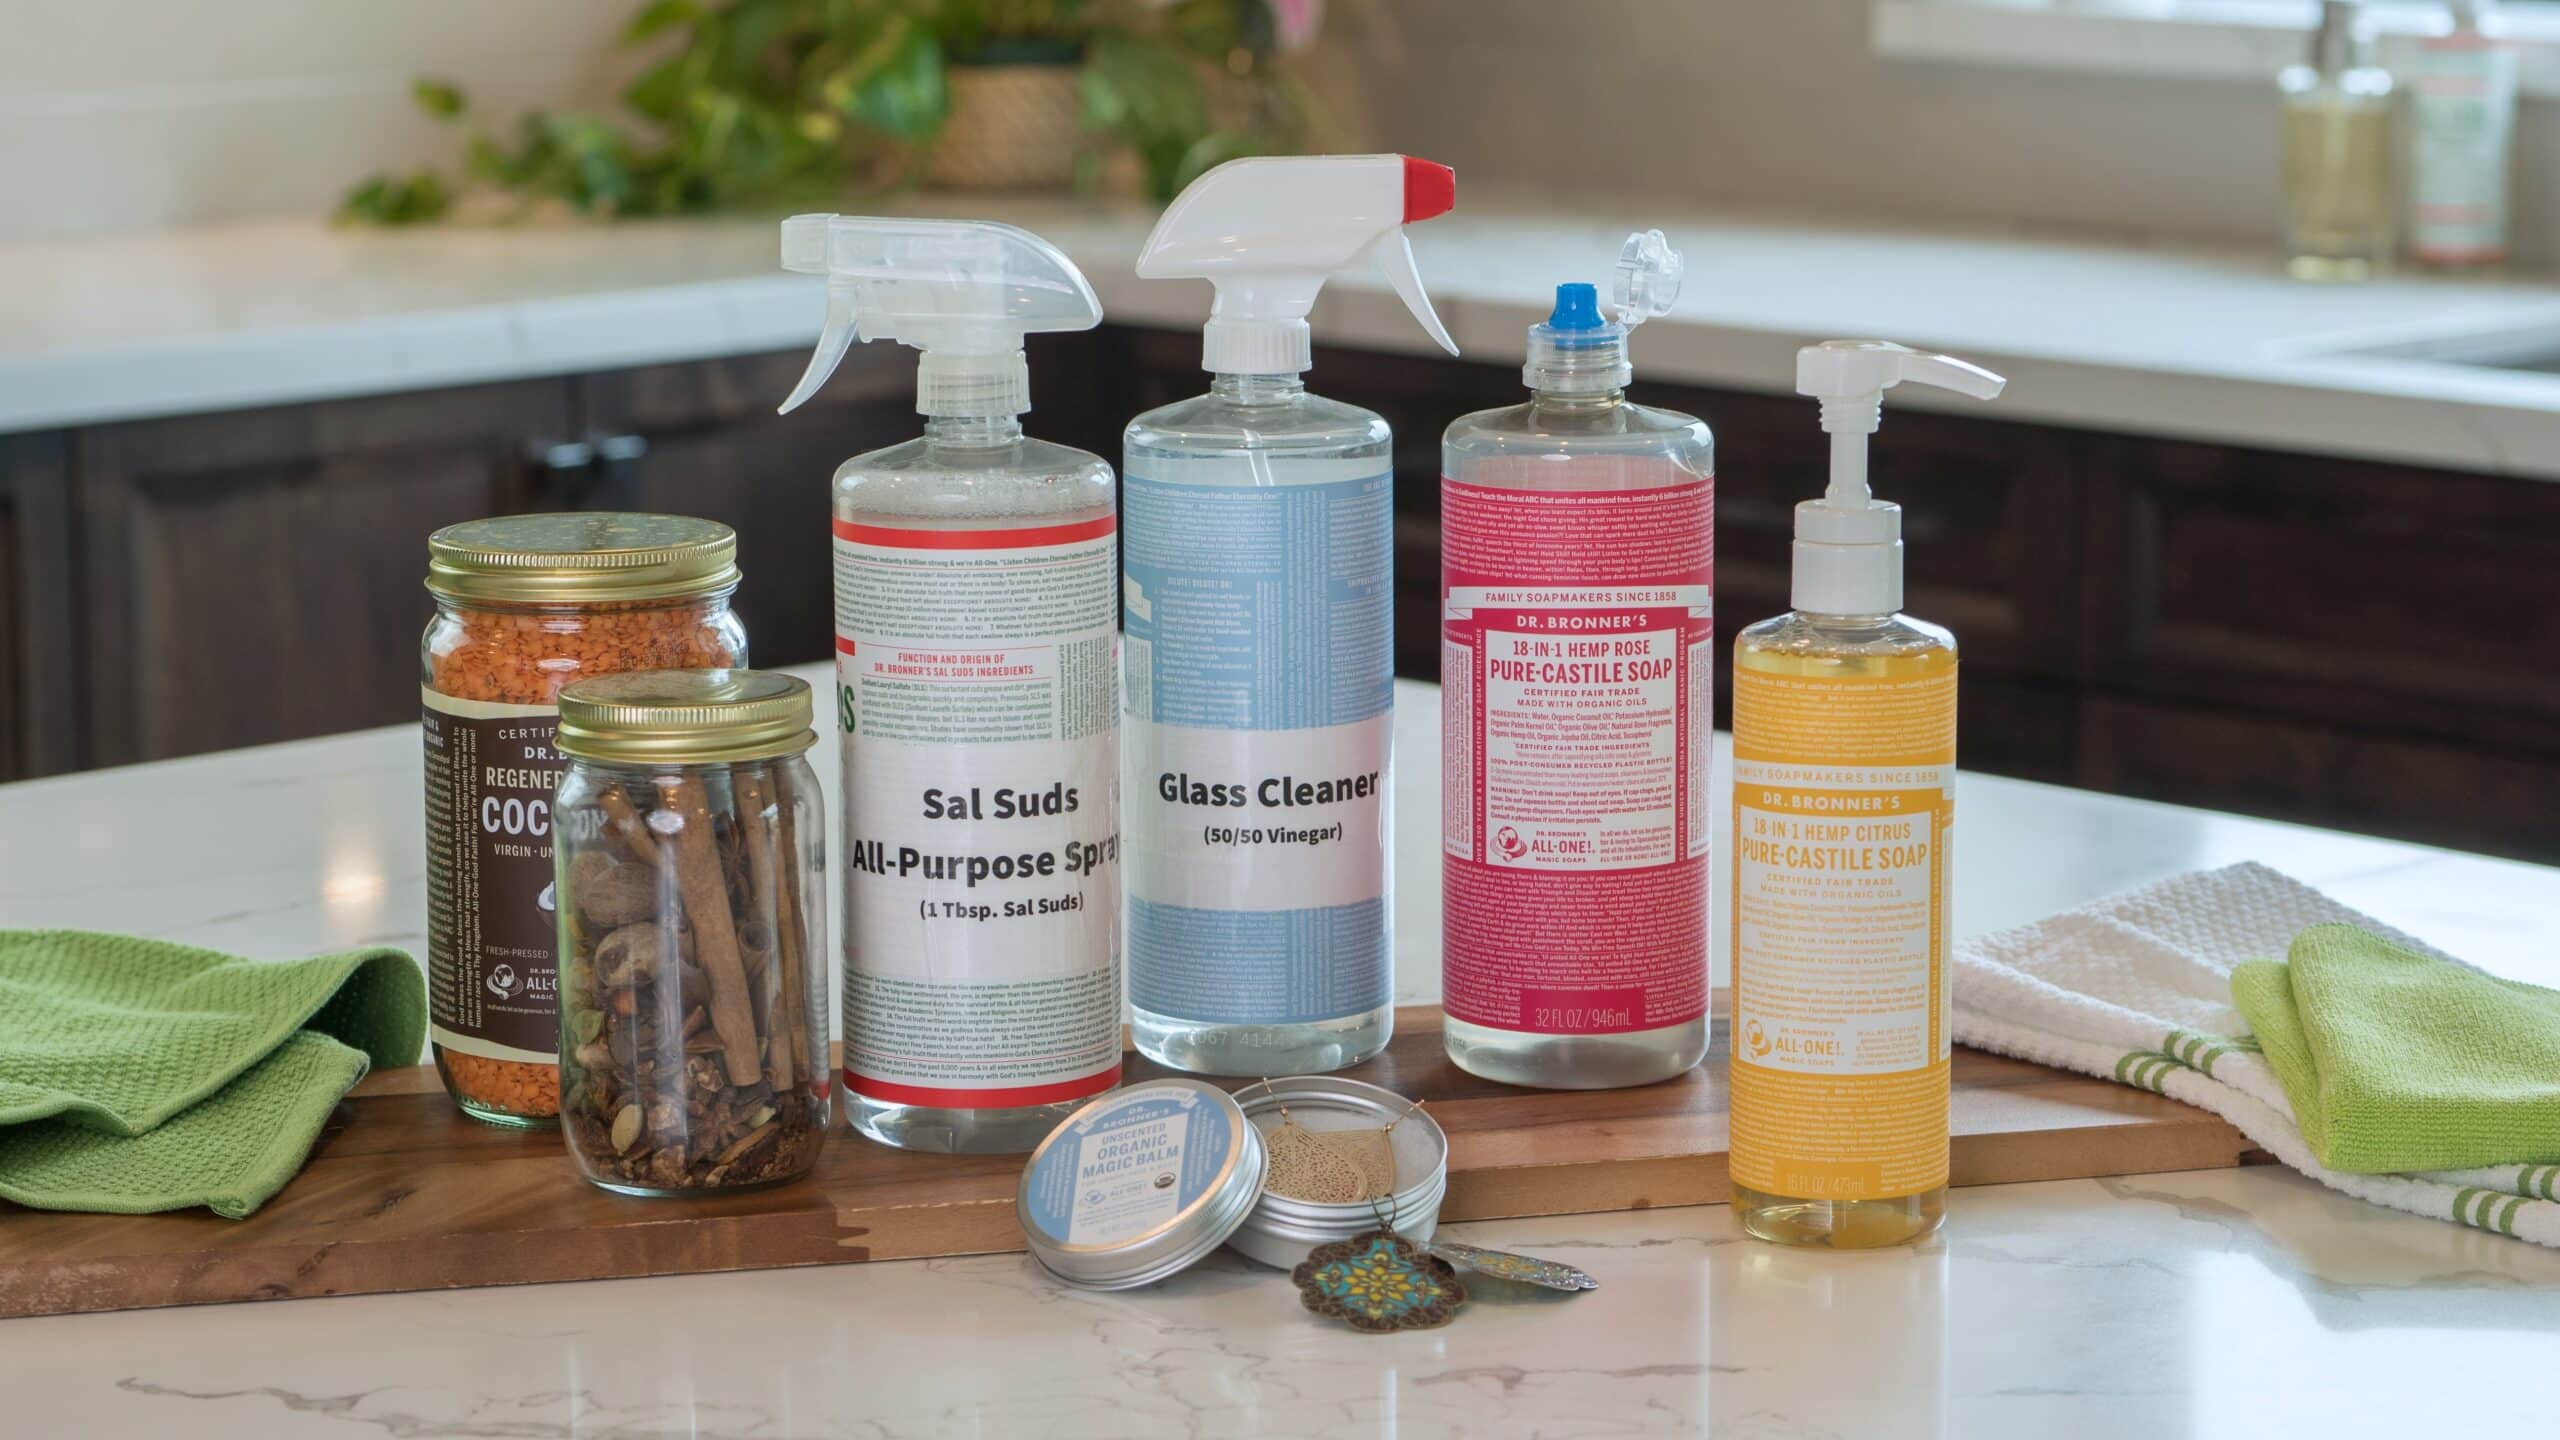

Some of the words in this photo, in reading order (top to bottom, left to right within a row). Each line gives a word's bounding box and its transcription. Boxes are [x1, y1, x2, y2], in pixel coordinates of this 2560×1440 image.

[1486, 592, 1522, 603] FAMILY
[1527, 593, 1612, 603] SOAPMAKERS
[1617, 592, 1650, 602] SINCE
[1654, 591, 1677, 601] 1858
[1516, 615, 1543, 628] DR.
[1548, 614, 1647, 629] BRONNER'S
[898, 651, 938, 664] FUNCTION
[941, 654, 958, 665] AND
[961, 654, 991, 665] ORIGIN
[994, 653, 1006, 664] OF
[1513, 640, 1561, 657] 18-IN-1
[1568, 642, 1609, 658] HEMP
[1615, 639, 1650, 656] ROSE
[888, 663, 931, 676] BRONNER'S
[934, 666, 949, 677] SAL
[952, 666, 974, 677] SUDS
[977, 663, 1034, 677] INGREDIENTS
[1490, 658, 1623, 685] PURE-CASTILE
[1628, 658, 1673, 682] SOAP
[1523, 687, 1578, 698] CERTIFIED
[1581, 688, 1604, 697] FAIR
[1608, 687, 1641, 696] TRADE
[1517, 698, 1544, 708] MADE
[1547, 700, 1573, 708] WITH
[1577, 700, 1622, 709] ORGANIC
[1626, 697, 1648, 707] OILS
[460, 727, 468, 751] whole
[1602, 742, 1650, 751] INGREDIENTS
[524, 746, 554, 760] DR.
[1510, 760, 1572, 769] POST-CONSUMER
[1575, 761, 1613, 769] RECYCLED
[1615, 759, 1645, 768] PLASTIC
[461, 770, 469, 790] unite
[469, 765, 478, 796] All-One
[1767, 769, 1864, 784] SOAPMAKERS
[1869, 772, 1913, 784] SINCE
[1159, 772, 1247, 808] Glass
[1257, 770, 1379, 808] Cleaner
[454, 782, 463, 821] prepared
[922, 787, 984, 820] Sal
[993, 781, 1079, 820] Suds
[1762, 792, 1788, 807] DR.
[1791, 795, 1900, 811] BRONNER'S
[1204, 825, 1264, 846] (50/50
[1267, 822, 1343, 845] Vinegar)
[1805, 824, 1849, 842] HEMP
[1855, 822, 1911, 842] CITRUS
[454, 842, 462, 868] hands
[494, 843, 530, 857] VIRGIN
[1531, 840, 1592, 854] ALL-ONE!
[1742, 837, 1873, 870] PURE-CASTILE
[1878, 843, 1928, 870] SOAP
[852, 838, 1056, 888] All-Purpose
[1766, 873, 1821, 886] CERTIFIED
[1826, 877, 1852, 887] FAIR
[1857, 876, 1895, 886] TRADE
[1760, 883, 1786, 895] MADE
[1789, 887, 1818, 898] WITH
[1821, 890, 1874, 899] ORGANIC
[1877, 889, 1903, 898] OILS
[920, 899, 937, 920] (1
[943, 901, 998, 922] Tbsp.
[1004, 899, 1034, 918] Sal
[1038, 891, 1084, 915] Suds)
[456, 914, 464, 936] bless
[463, 911, 471, 928] that
[472, 913, 482, 952] Kingdom,
[456, 946, 464, 965] food
[464, 961, 473, 996] strength
[529, 993, 554, 1001] MAGIC
[457, 1008, 465, 1025] God
[466, 1010, 474, 1027] give
[1535, 1008, 1550, 1028] 32
[1552, 1009, 1566, 1028] FL
[1775, 1037, 1841, 1056] ALL-ONE!
[1101, 1122, 1167, 1146] UNSCENTED
[1097, 1133, 1168, 1160] ORGANIC
[1082, 1155, 1133, 1180] MAGIC
[1135, 1145, 1179, 1166] BALM
